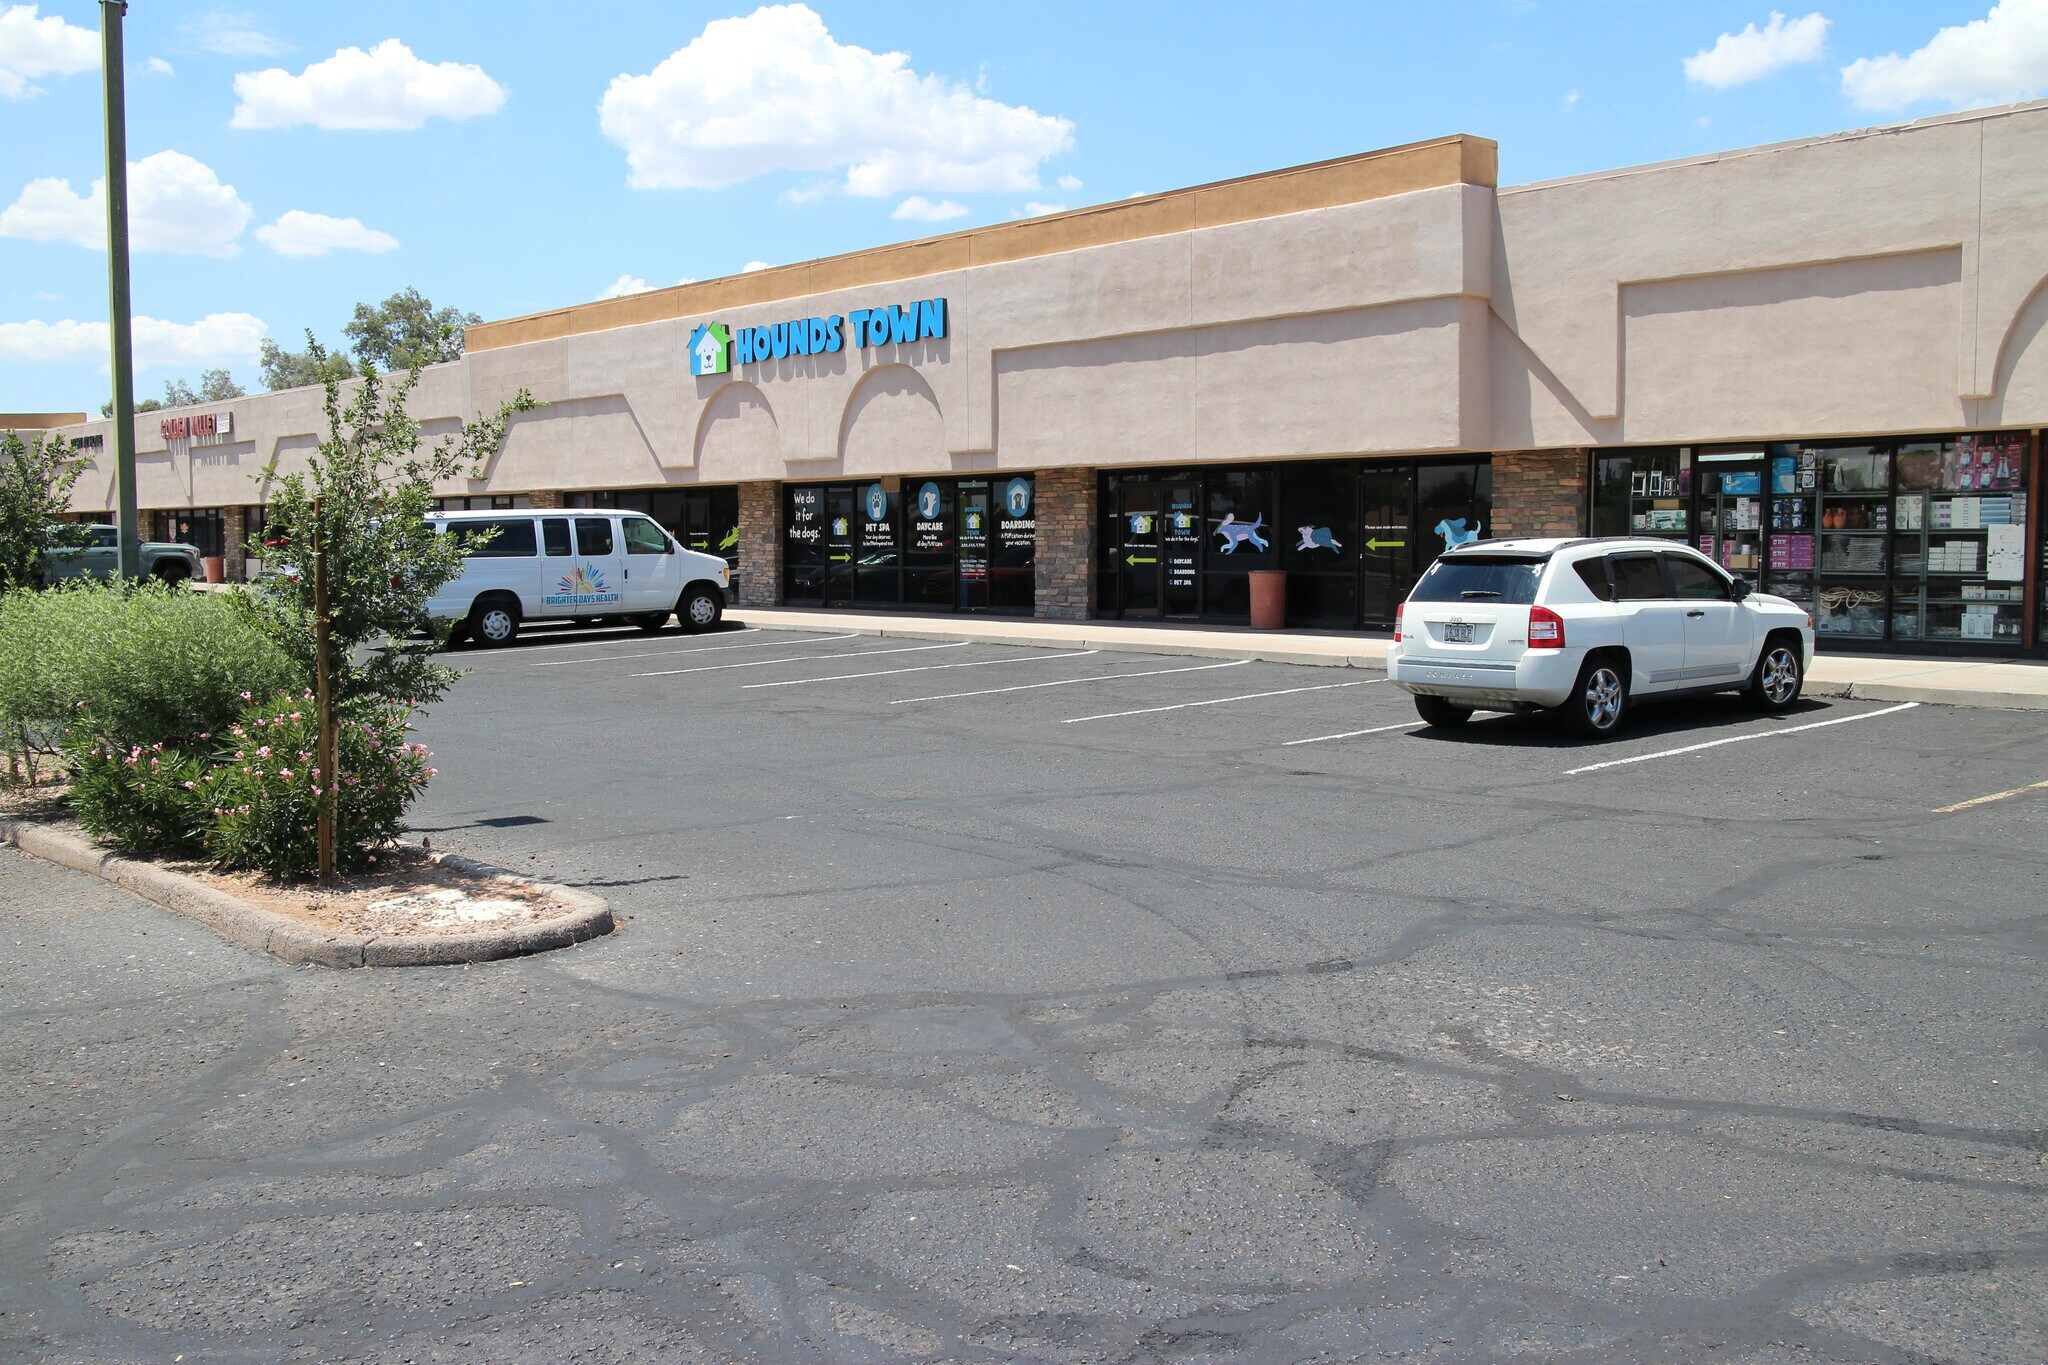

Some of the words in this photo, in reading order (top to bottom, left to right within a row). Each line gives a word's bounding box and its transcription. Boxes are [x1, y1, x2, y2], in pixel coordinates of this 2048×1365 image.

[736, 315, 844, 365] HOUNDS
[849, 298, 947, 348] TOWN
[160, 417, 190, 440] GOLDEN
[191, 413, 217, 436] VALLEY
[793, 493, 805, 504] We
[806, 491, 815, 504] do
[795, 511, 801, 521] it
[802, 507, 813, 522] for
[865, 523, 877, 532] PET
[879, 522, 890, 532] SPA
[916, 522, 944, 531] DAYCARE
[1000, 519, 1035, 530] BOARDING
[789, 525, 801, 538] the
[546, 595, 578, 605] BRIGHTER
[579, 594, 595, 604] DAYS
[595, 593, 619, 603] HEALTH
